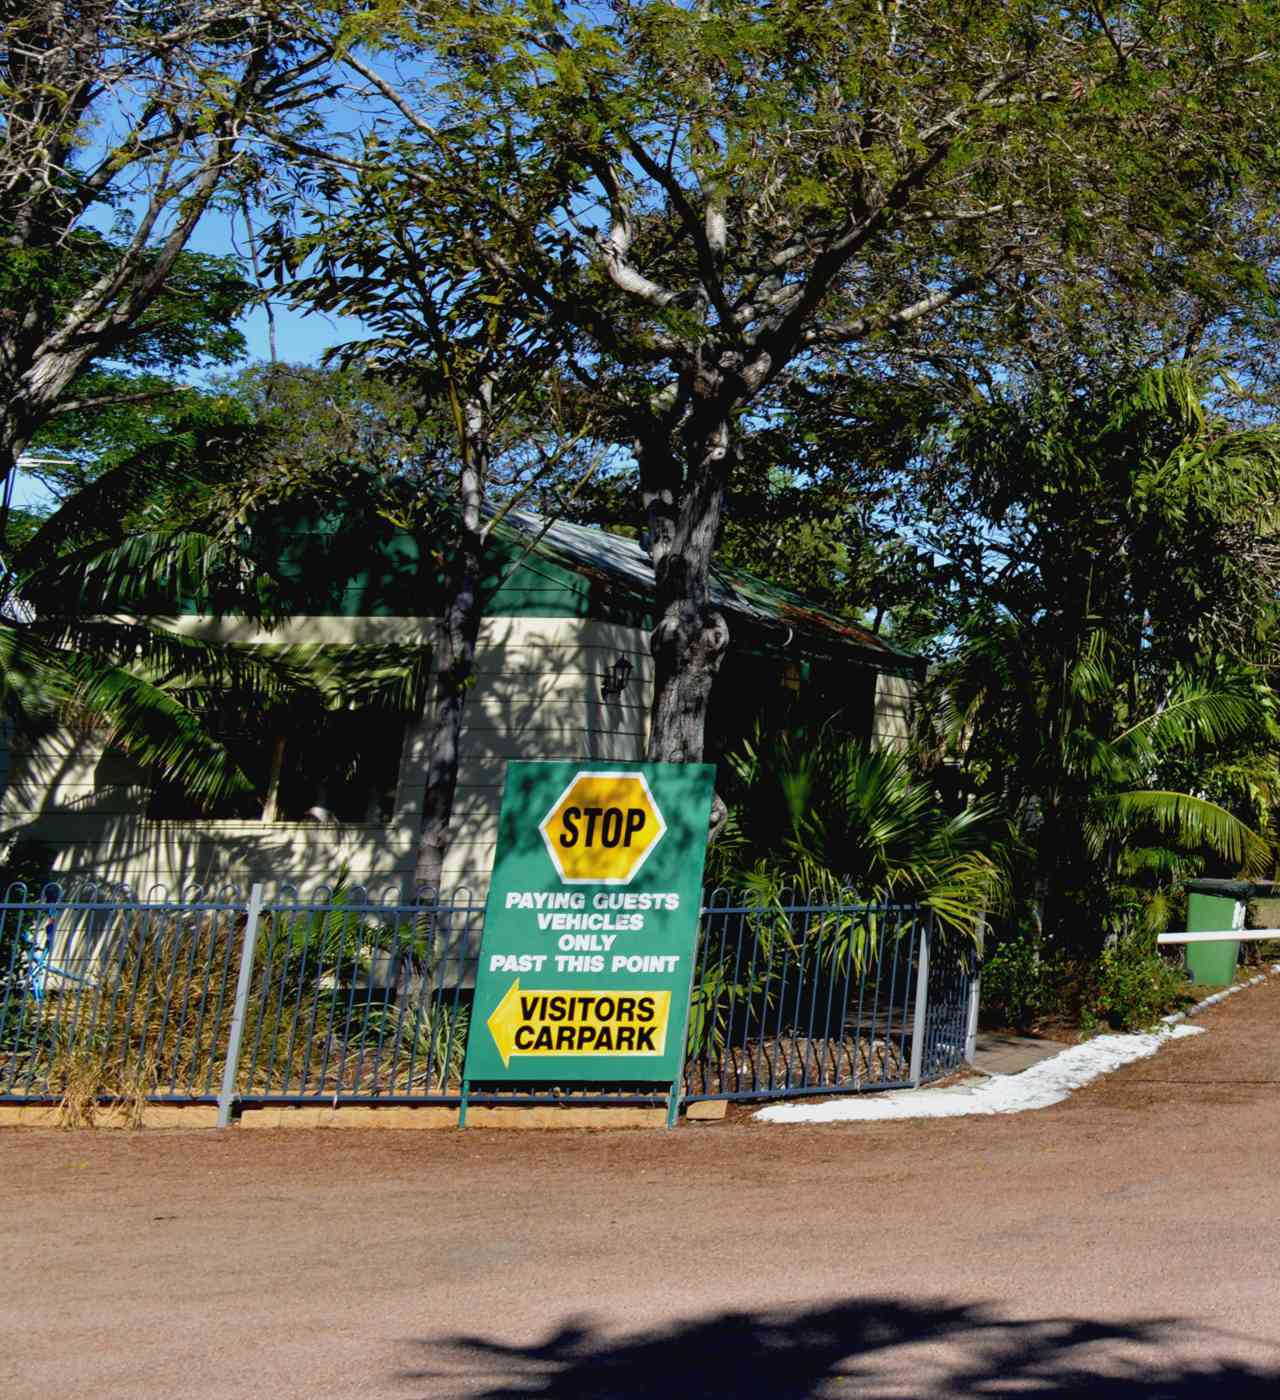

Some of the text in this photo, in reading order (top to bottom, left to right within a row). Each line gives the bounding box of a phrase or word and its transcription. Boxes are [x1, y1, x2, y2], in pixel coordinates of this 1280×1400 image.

[559, 806, 646, 849] STOP
[504, 892, 680, 910] PAYING GUESTS
[537, 913, 644, 931] VEHICLES
[558, 934, 616, 951] ONLY
[490, 955, 680, 972] PAST THIS POINT
[519, 996, 656, 1021] VISITORS
[514, 1026, 657, 1051] CARPARK
